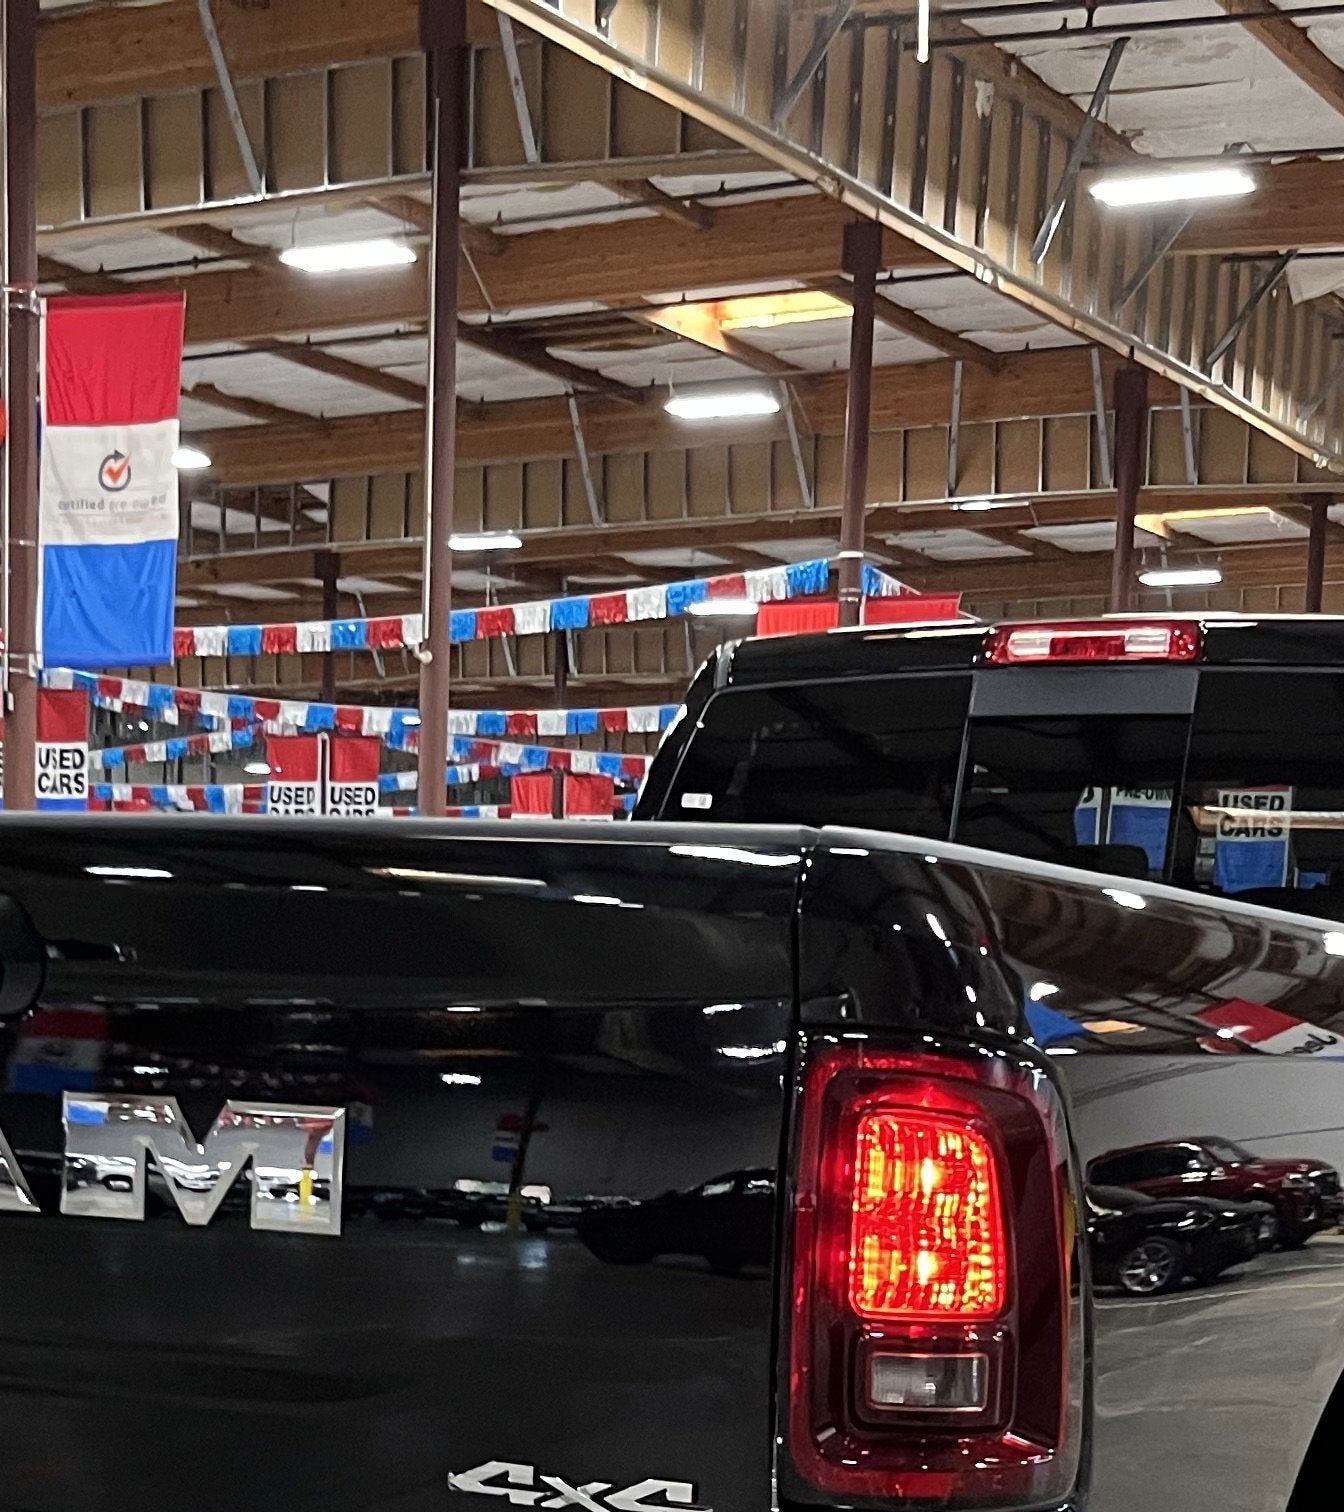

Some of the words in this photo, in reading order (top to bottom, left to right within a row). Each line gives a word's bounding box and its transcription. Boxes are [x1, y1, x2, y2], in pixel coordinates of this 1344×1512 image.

[38, 747, 85, 769] USED
[37, 772, 85, 794] CARS
[270, 785, 315, 806] USED
[330, 785, 376, 806] USED
